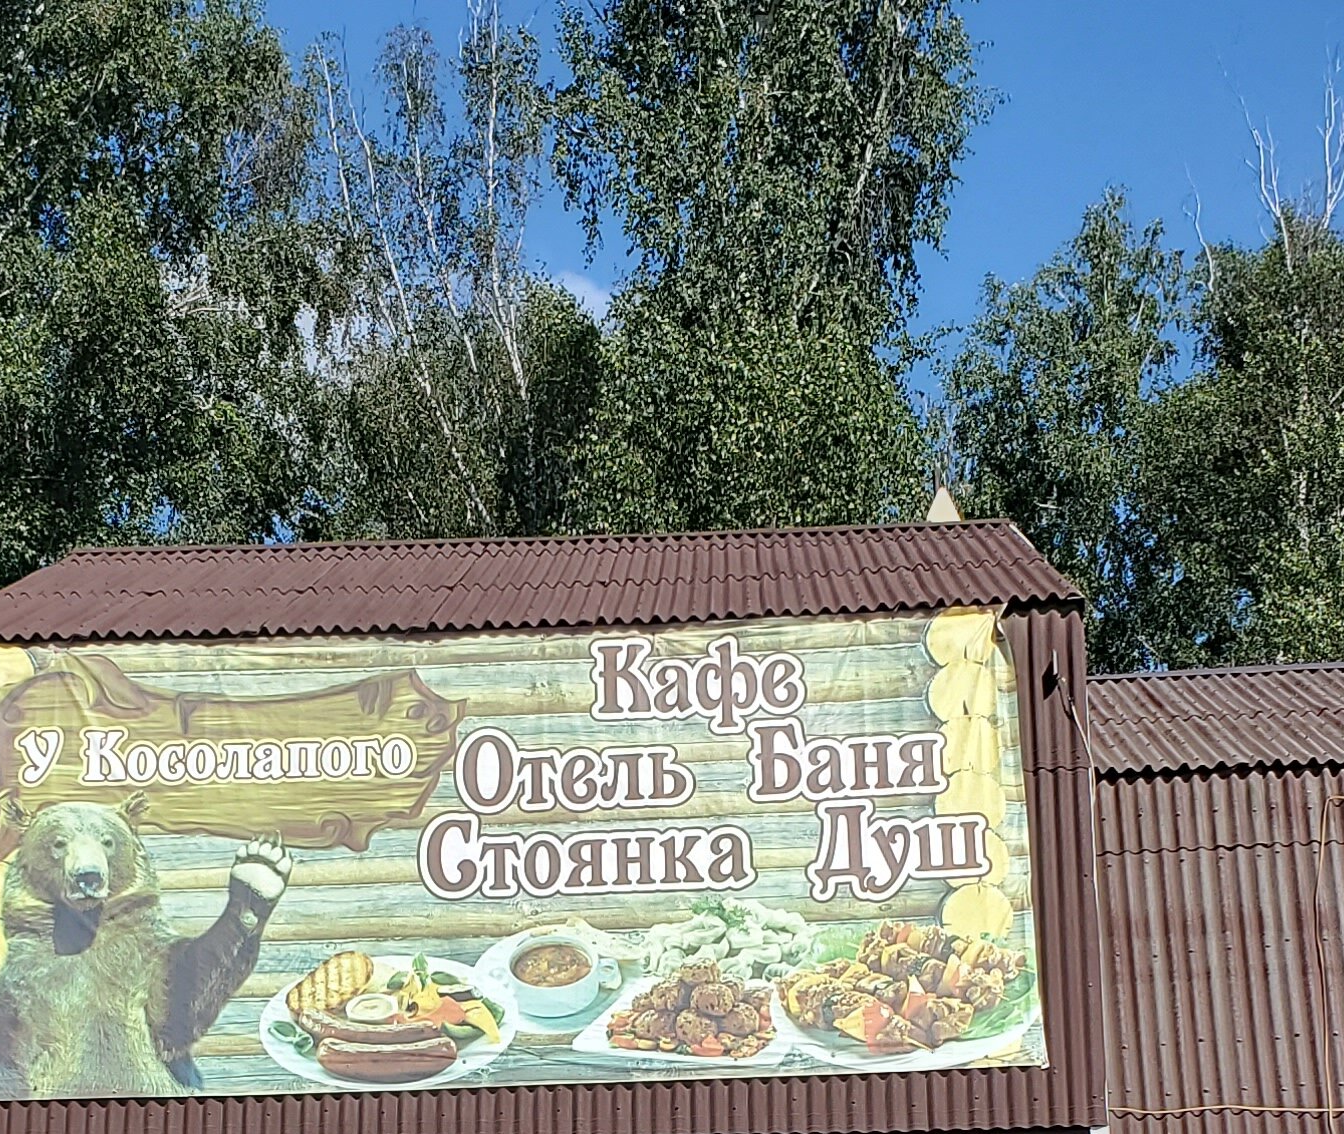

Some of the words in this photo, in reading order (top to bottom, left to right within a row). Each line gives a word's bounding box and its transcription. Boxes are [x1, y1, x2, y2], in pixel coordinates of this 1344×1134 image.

[594, 638, 802, 731] Кафе
[82, 728, 414, 783] Косолапого
[458, 731, 691, 810] Отель
[752, 721, 943, 799] Баня
[423, 815, 753, 896] Стоянка
[810, 802, 986, 897] Душ
